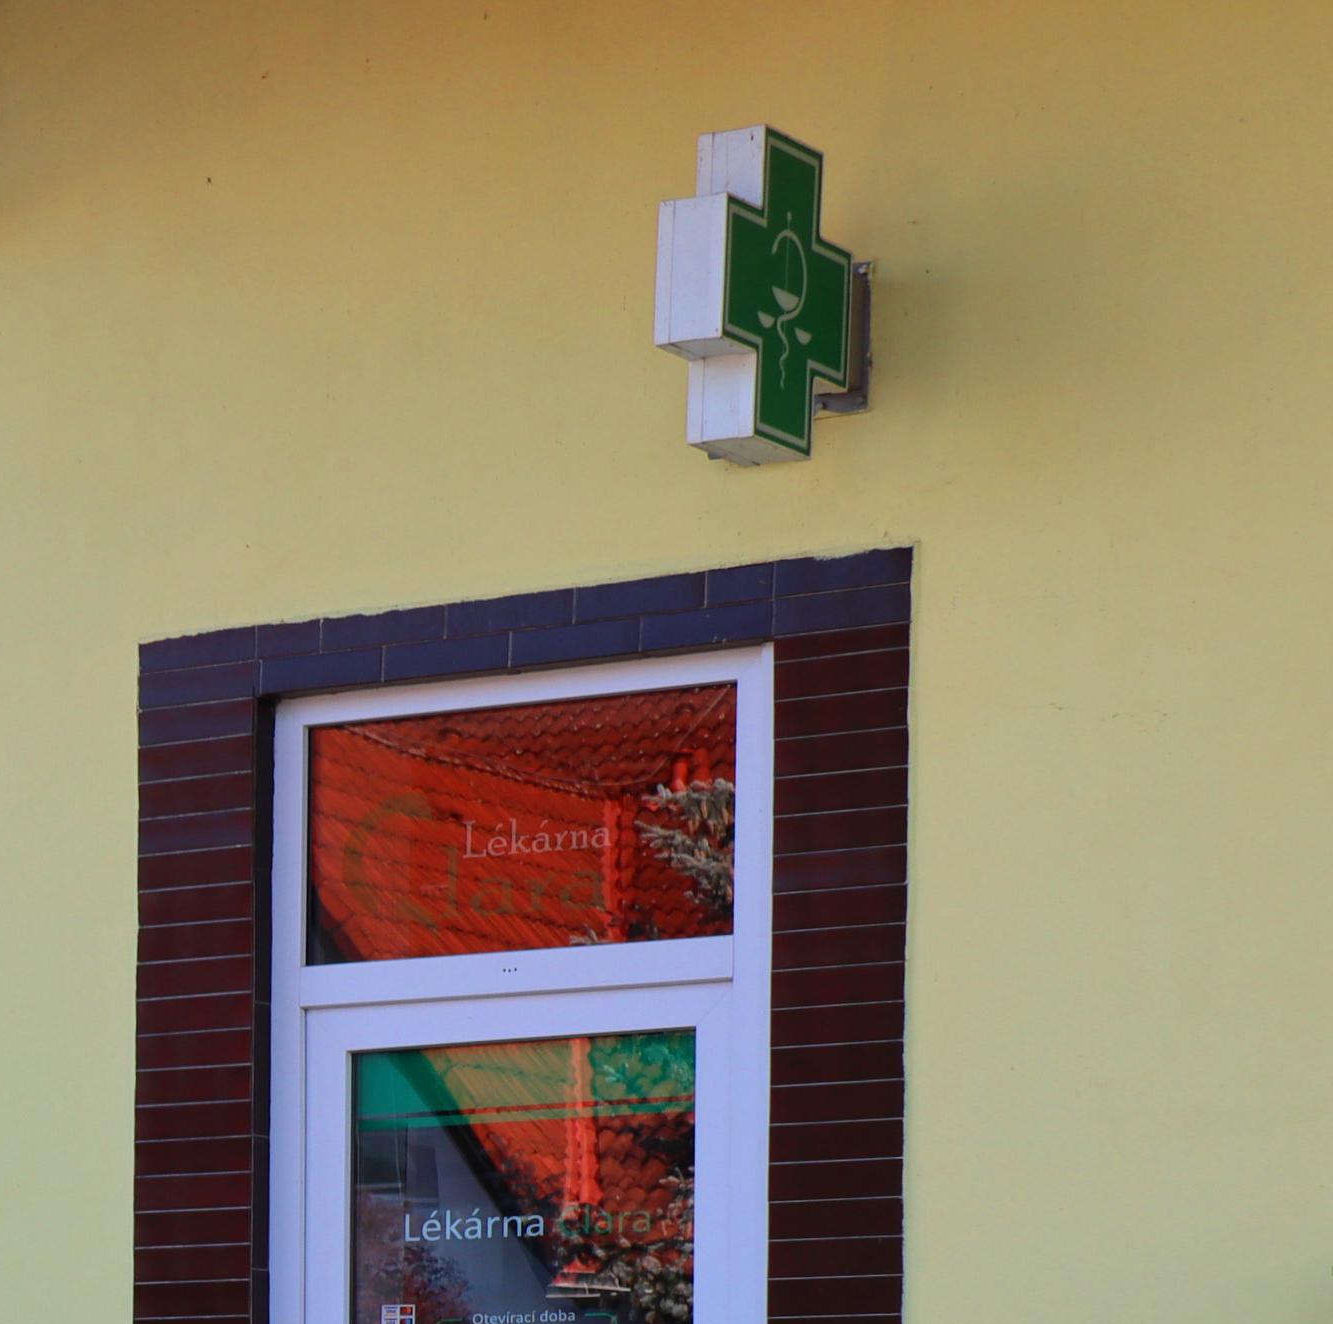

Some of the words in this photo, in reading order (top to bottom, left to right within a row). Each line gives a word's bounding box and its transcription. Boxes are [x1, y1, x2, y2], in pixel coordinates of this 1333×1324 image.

[462, 818, 611, 859] Lékárna
[342, 793, 606, 935] Clara
[403, 1208, 545, 1242] Lékárna
[558, 1203, 652, 1237] Clara
[539, 1309, 576, 1323] doba
